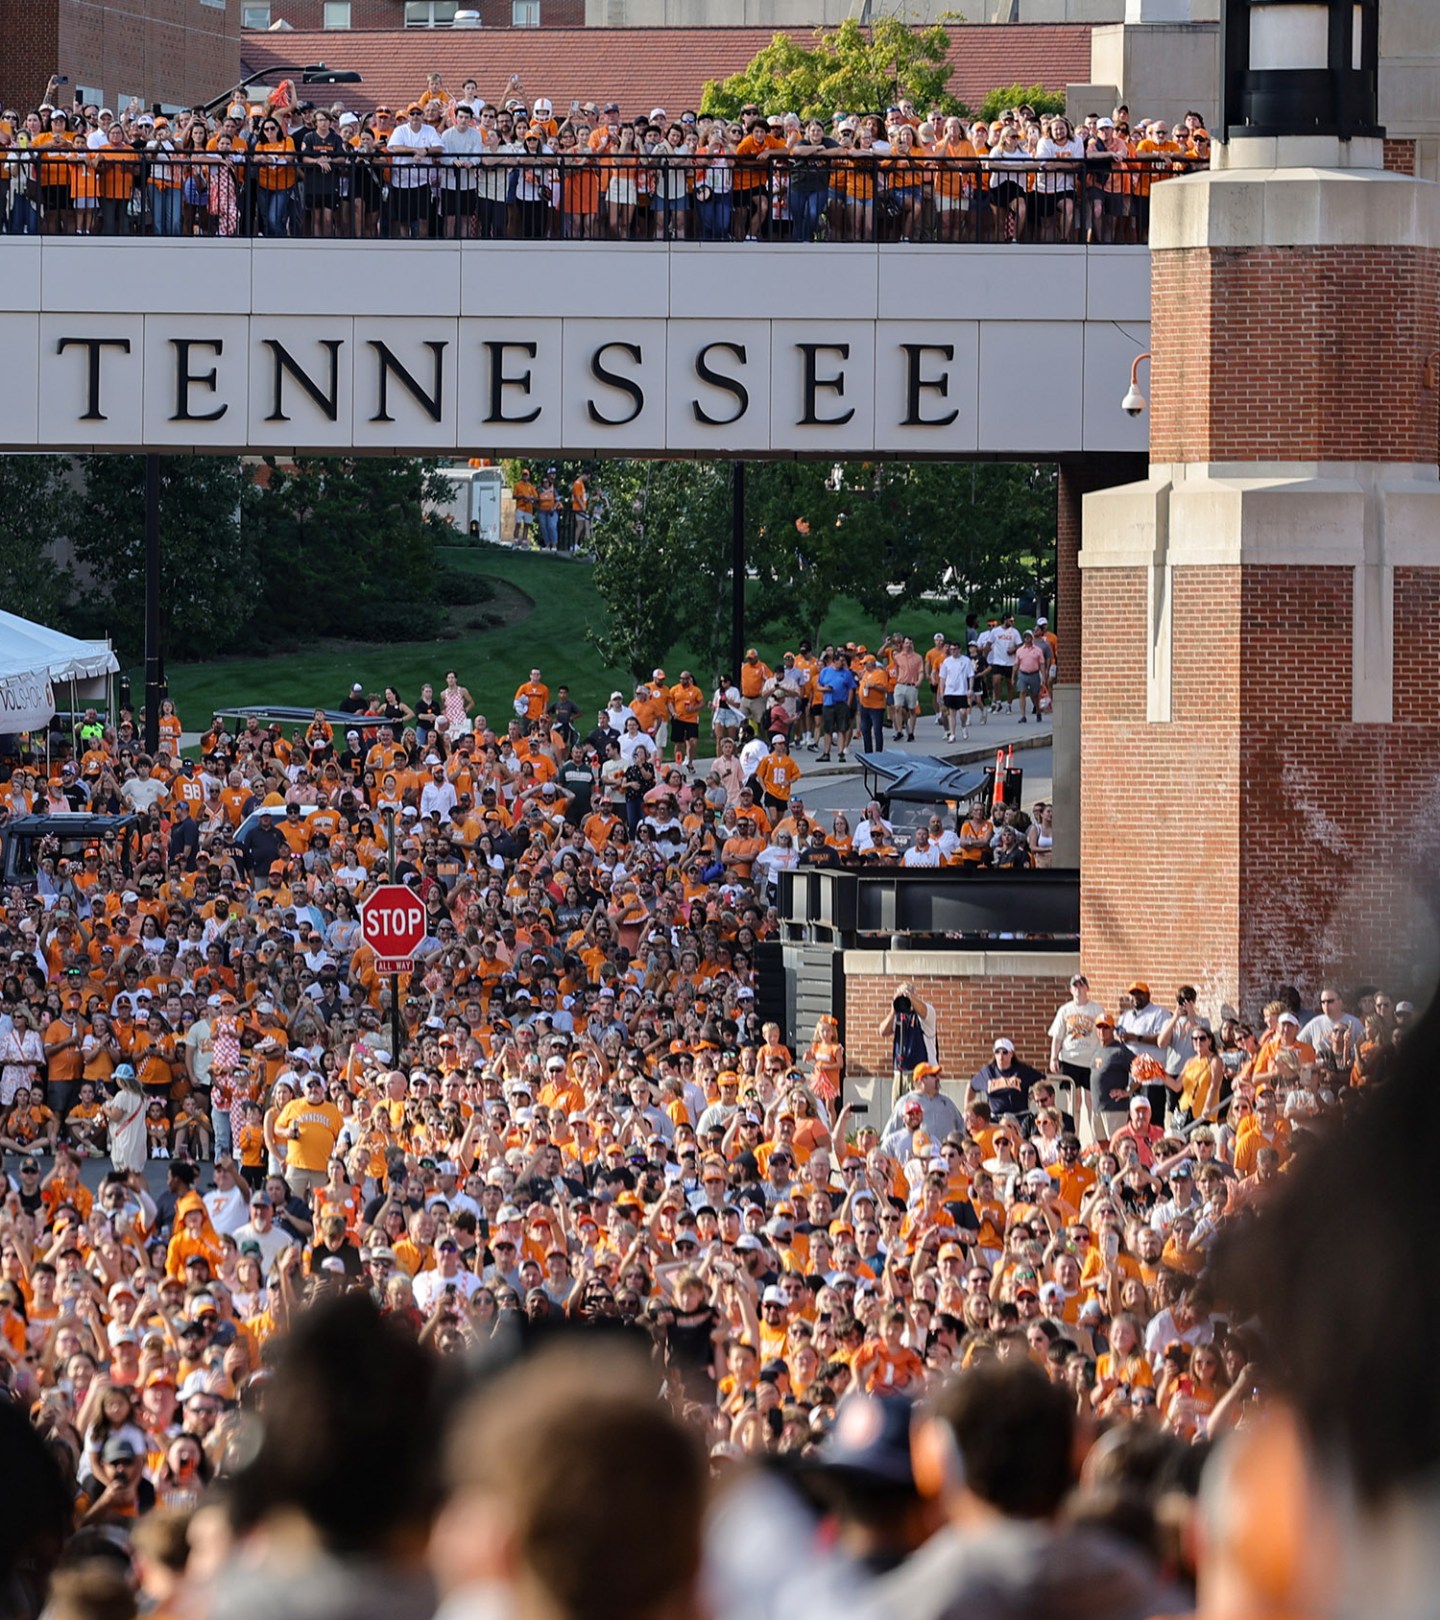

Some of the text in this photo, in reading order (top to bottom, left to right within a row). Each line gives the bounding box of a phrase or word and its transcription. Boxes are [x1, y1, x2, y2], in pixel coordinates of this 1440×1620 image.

[56, 338, 960, 427] TENNESSEE
[181, 784, 201, 801] 98
[232, 796, 242, 807] T
[366, 908, 422, 937] STOP
[378, 961, 412, 972] ALL WAY
[378, 977, 389, 989] T
